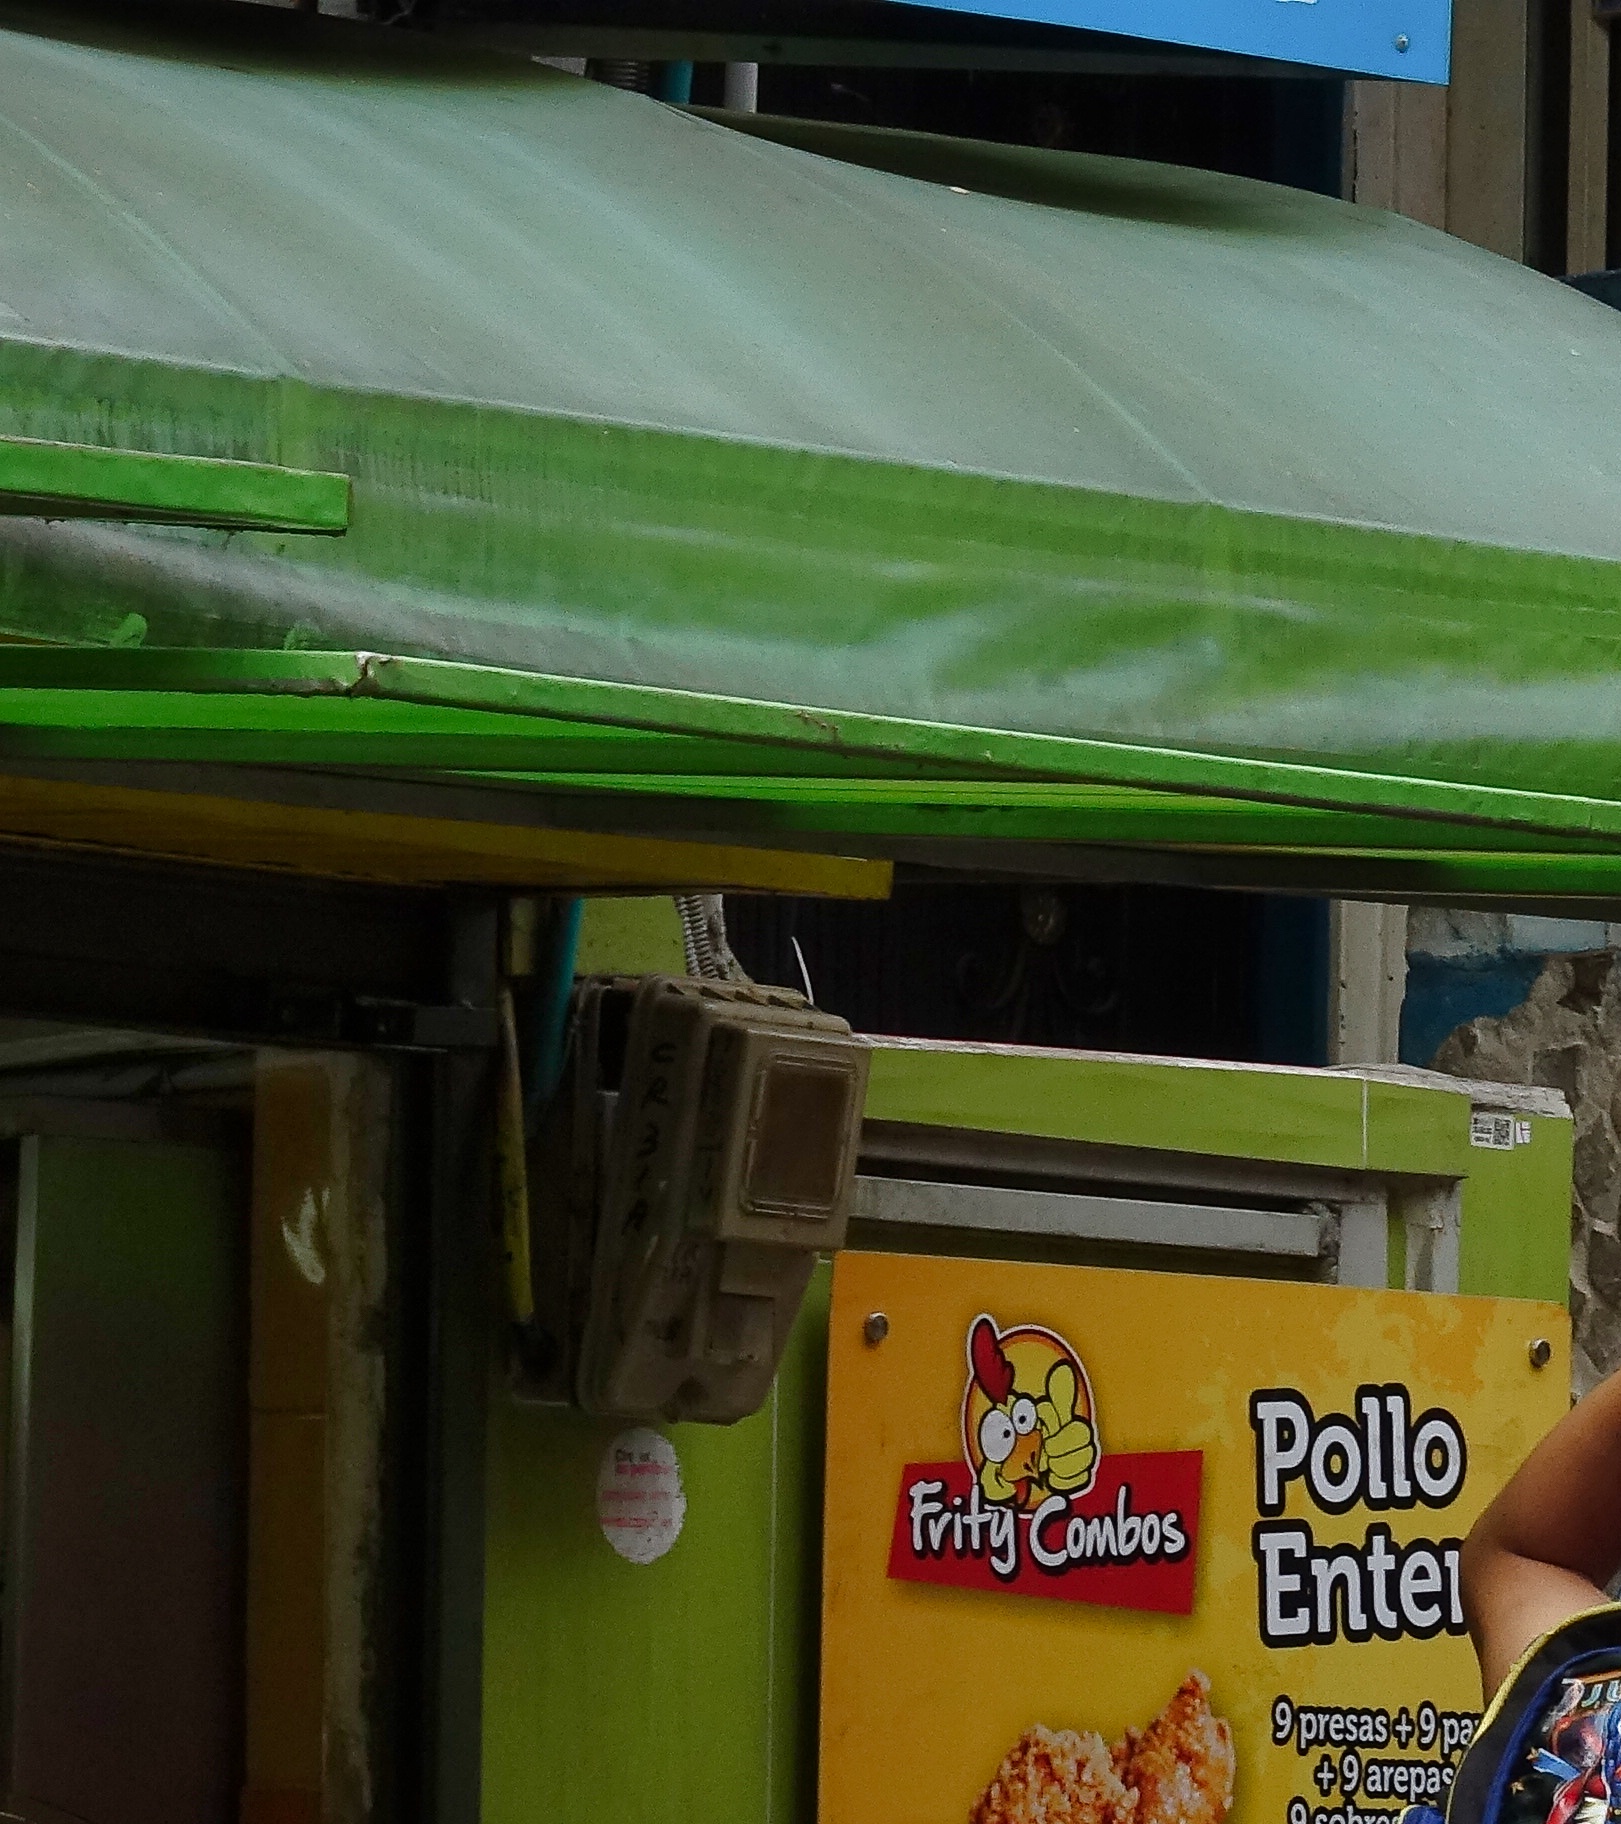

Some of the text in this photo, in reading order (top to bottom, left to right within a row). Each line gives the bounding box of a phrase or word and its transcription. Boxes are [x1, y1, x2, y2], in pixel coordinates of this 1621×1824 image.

[1252, 1388, 1465, 1513] Pollo
[908, 1480, 1188, 1576] Frity Combos
[1274, 1700, 1293, 1741] 9
[1298, 1708, 1389, 1753] presas
[1418, 1706, 1437, 1745] 9
[1443, 1716, 1480, 1754] pa
[1341, 1753, 1360, 1793] 9
